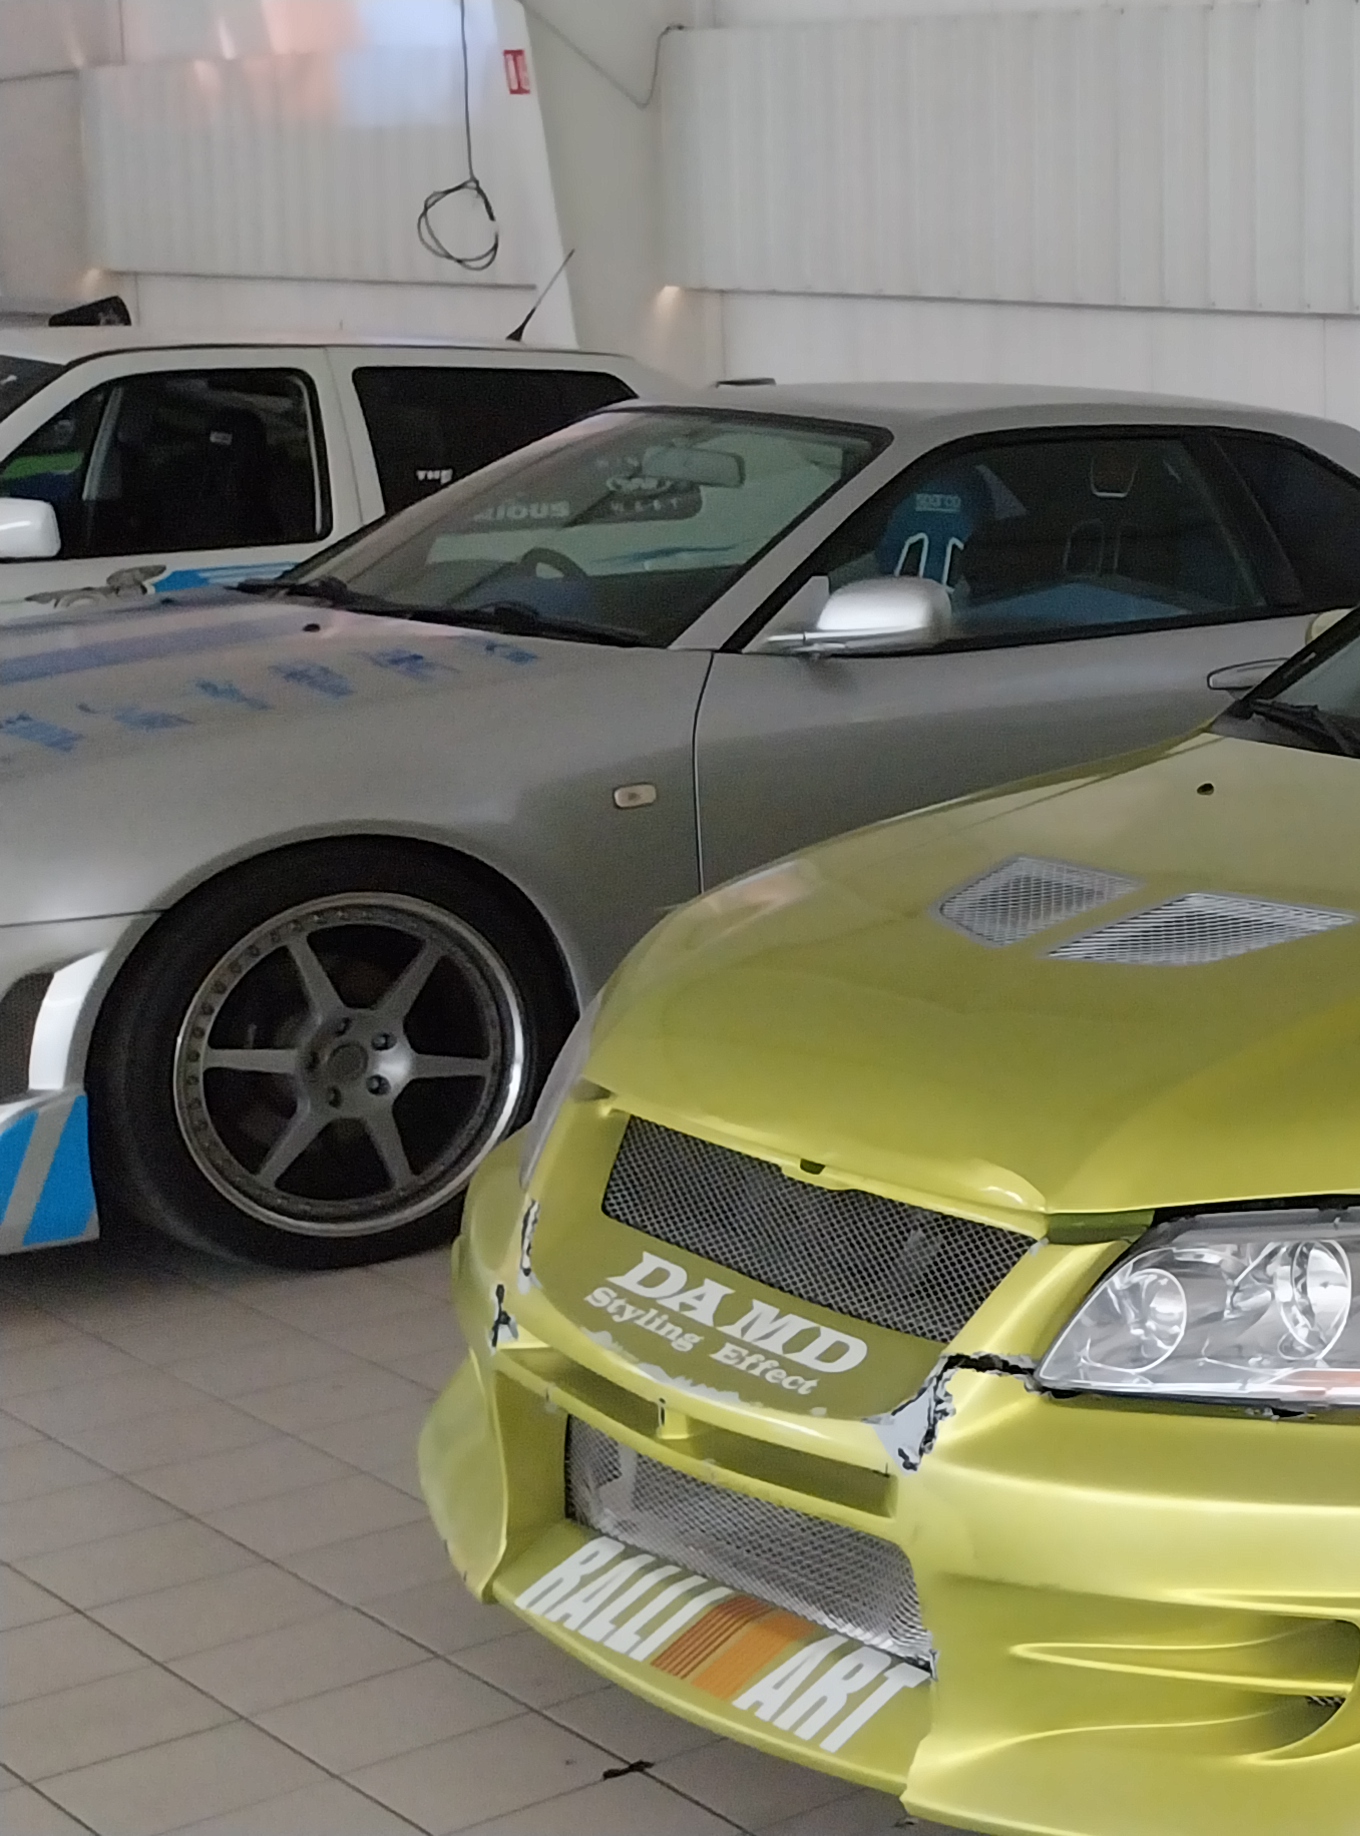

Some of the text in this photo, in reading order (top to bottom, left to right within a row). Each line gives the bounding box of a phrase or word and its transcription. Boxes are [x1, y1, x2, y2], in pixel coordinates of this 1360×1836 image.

[584, 1286, 820, 1395] Styling Effect
[606, 1251, 868, 1373] DAMD
[514, 1535, 932, 1753] RALLI ART
